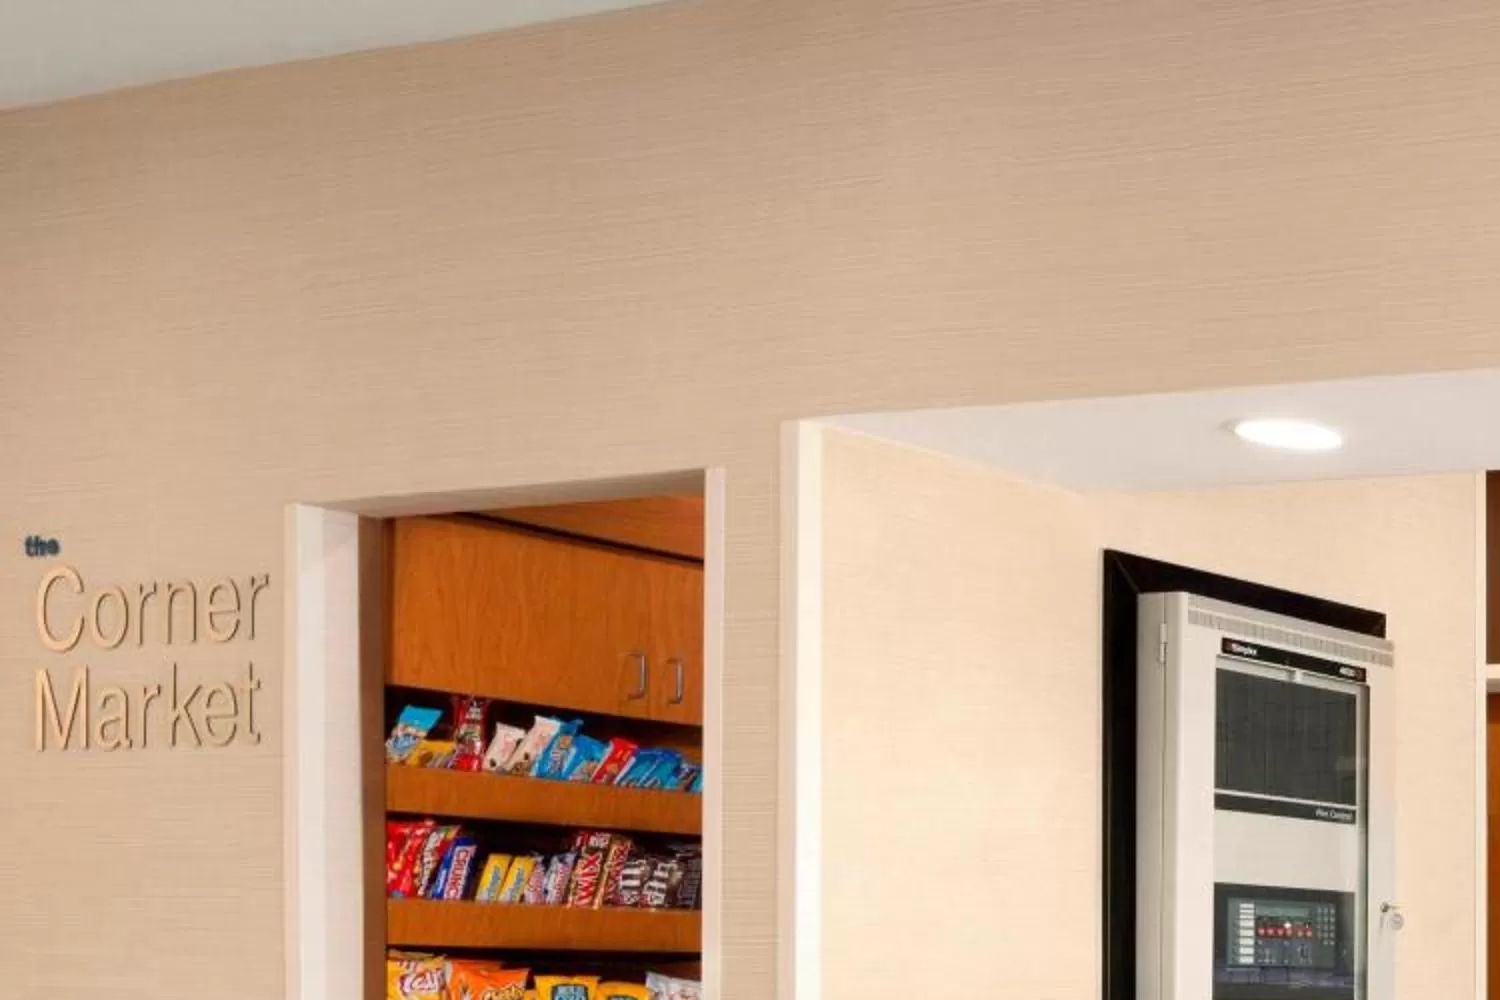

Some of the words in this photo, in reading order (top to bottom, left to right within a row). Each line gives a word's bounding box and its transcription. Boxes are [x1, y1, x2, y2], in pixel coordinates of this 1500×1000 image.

[24, 535, 60, 557] the
[36, 565, 270, 652] Corner
[35, 661, 261, 752] Market
